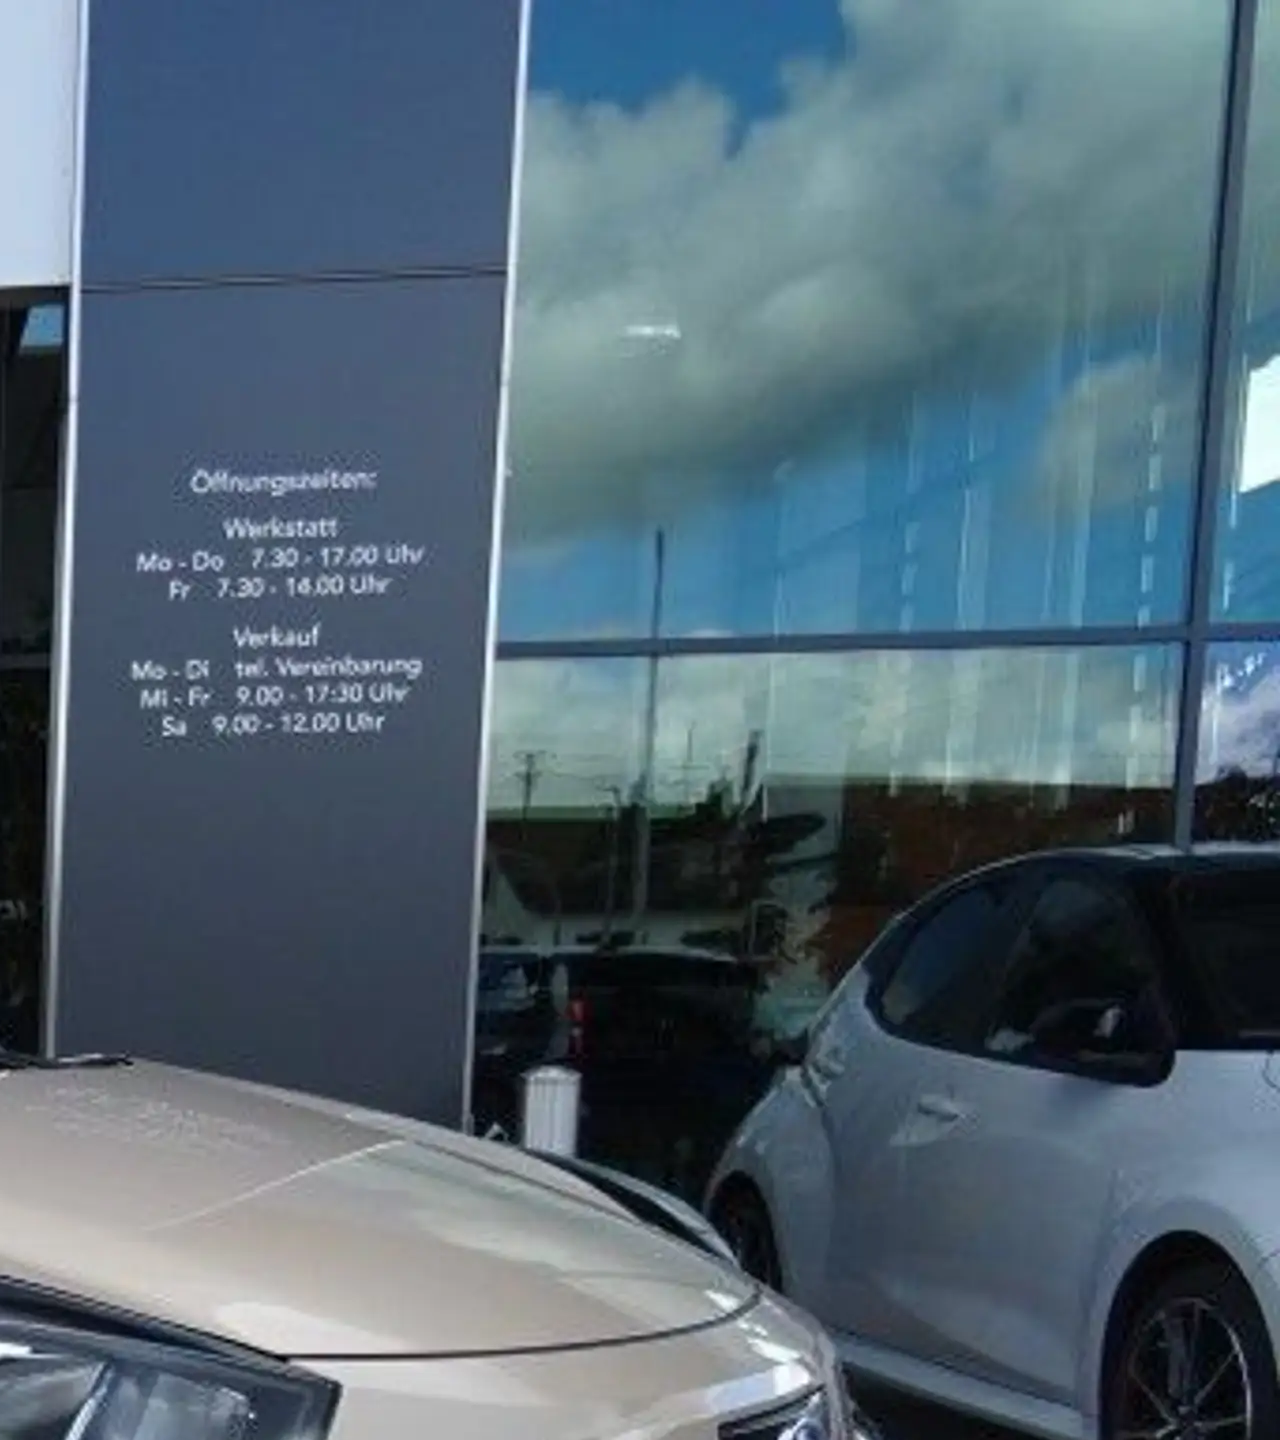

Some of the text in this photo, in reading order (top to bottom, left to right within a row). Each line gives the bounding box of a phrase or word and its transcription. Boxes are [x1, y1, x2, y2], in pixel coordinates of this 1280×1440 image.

[223, 516, 338, 541] Werkstatt
[136, 552, 173, 573] Mo
[192, 550, 224, 572] Do
[251, 547, 298, 569] 7.30
[320, 545, 378, 567] 17.00
[386, 543, 425, 565] Uhr
[169, 579, 190, 601] Fr
[217, 576, 264, 598] 7.30
[350, 573, 391, 595] Uhr
[233, 623, 320, 648] Verkauf
[131, 659, 167, 681] Mo
[186, 658, 209, 679] Di
[274, 653, 423, 680] Vereinbarung
[140, 687, 168, 709] Mi
[188, 687, 211, 707] Fr
[236, 685, 284, 706] 9.00
[368, 681, 410, 702] Uhr
[161, 715, 187, 736] Sa
[212, 714, 260, 735] 9.00
[282, 711, 340, 733] 12.00
[345, 711, 385, 733] Uhr
